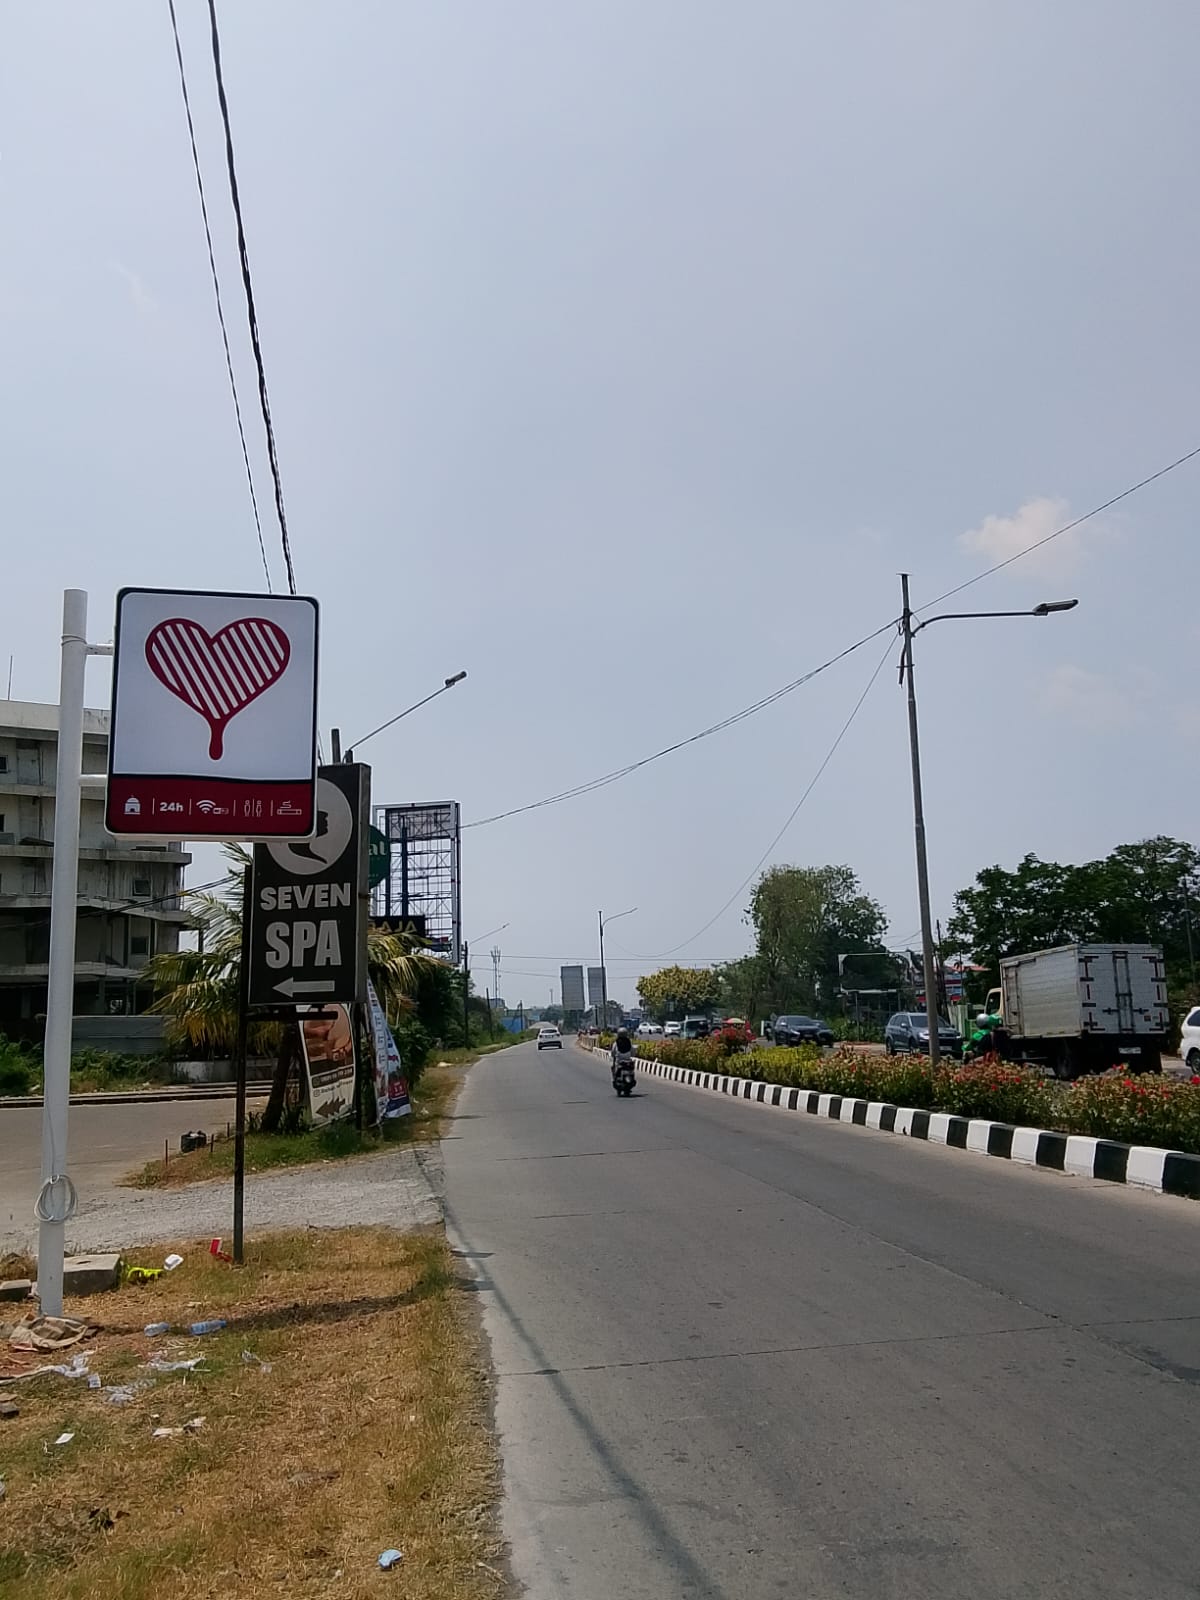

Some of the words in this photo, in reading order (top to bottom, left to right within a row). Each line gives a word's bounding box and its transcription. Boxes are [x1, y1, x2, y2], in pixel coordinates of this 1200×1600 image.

[159, 801, 184, 812] 24h
[260, 882, 351, 911] SEVEN
[265, 920, 342, 969] SPA
